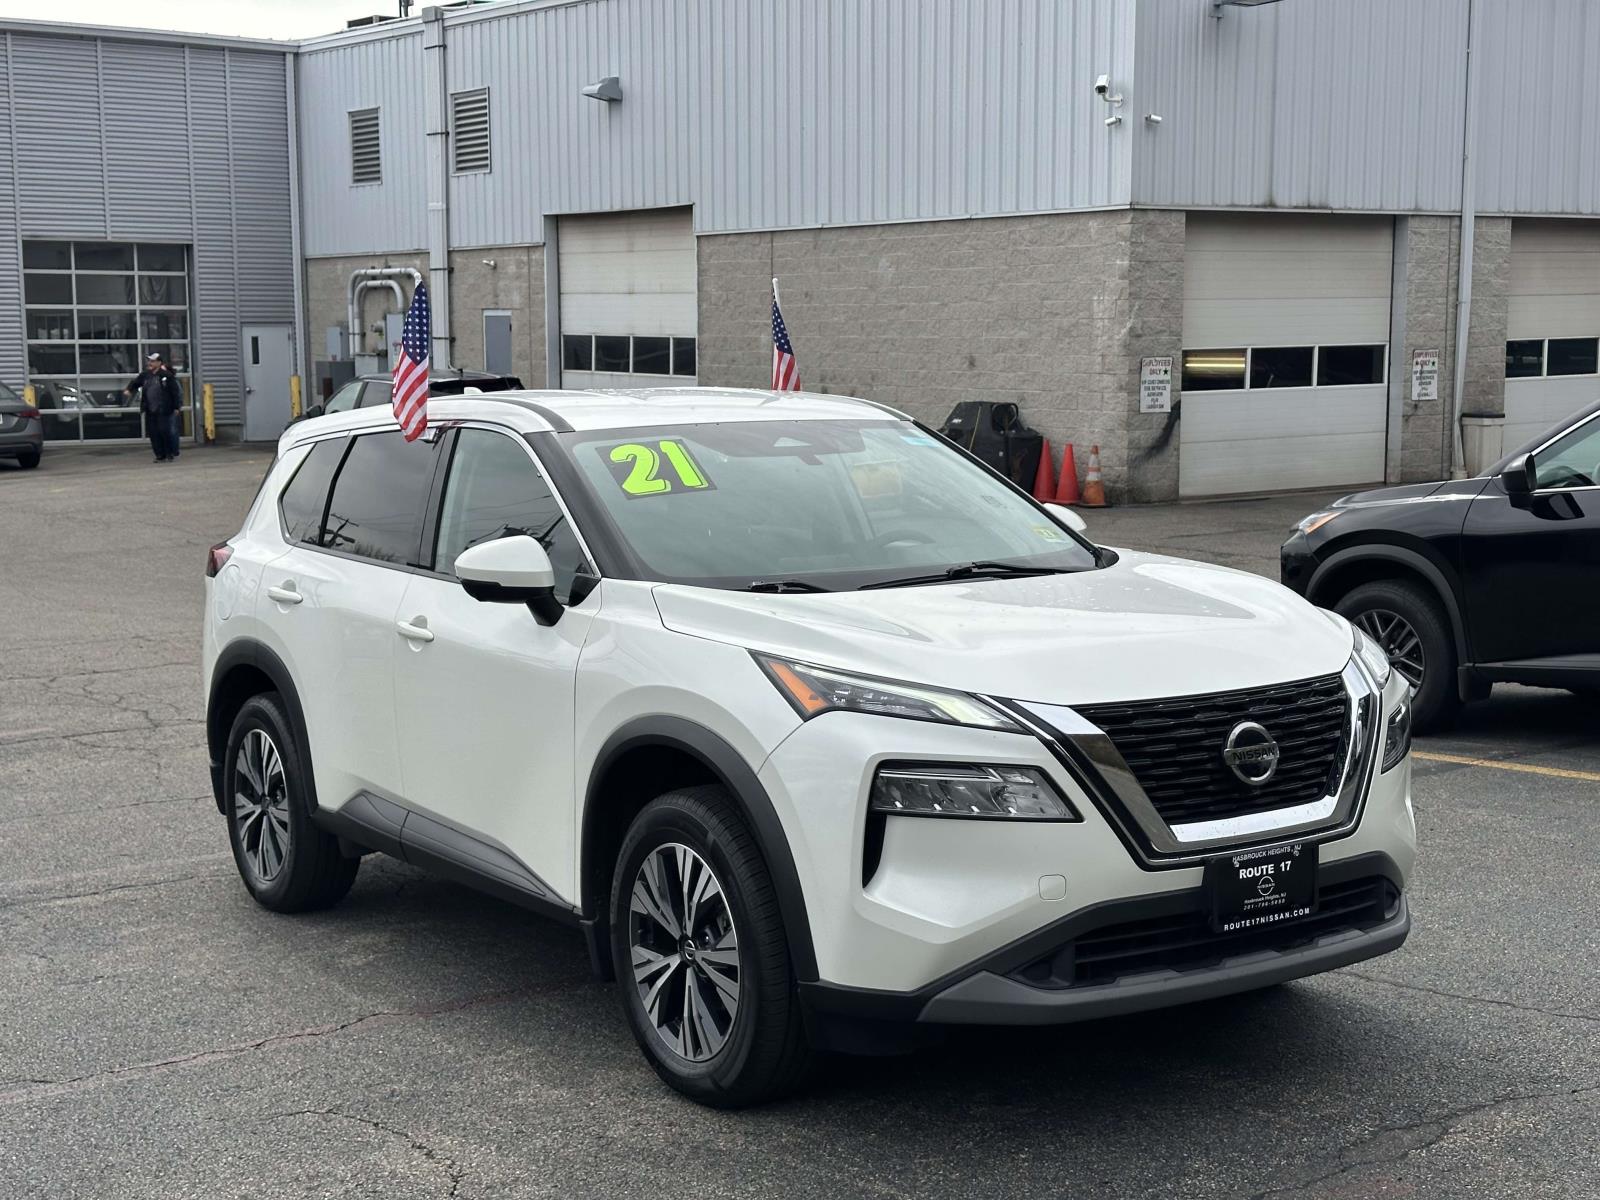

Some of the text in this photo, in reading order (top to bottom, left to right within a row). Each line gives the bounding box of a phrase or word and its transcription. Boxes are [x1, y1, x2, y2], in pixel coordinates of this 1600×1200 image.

[1142, 359, 1171, 367] EMPLOYEES
[610, 440, 709, 496] 21
[1231, 746, 1275, 761] NISSAN
[1232, 850, 1267, 863] HASBROUCK
[1239, 860, 1292, 879] ROUTE 17
[1223, 907, 1310, 931] ROUTE17NISSAN.COM
